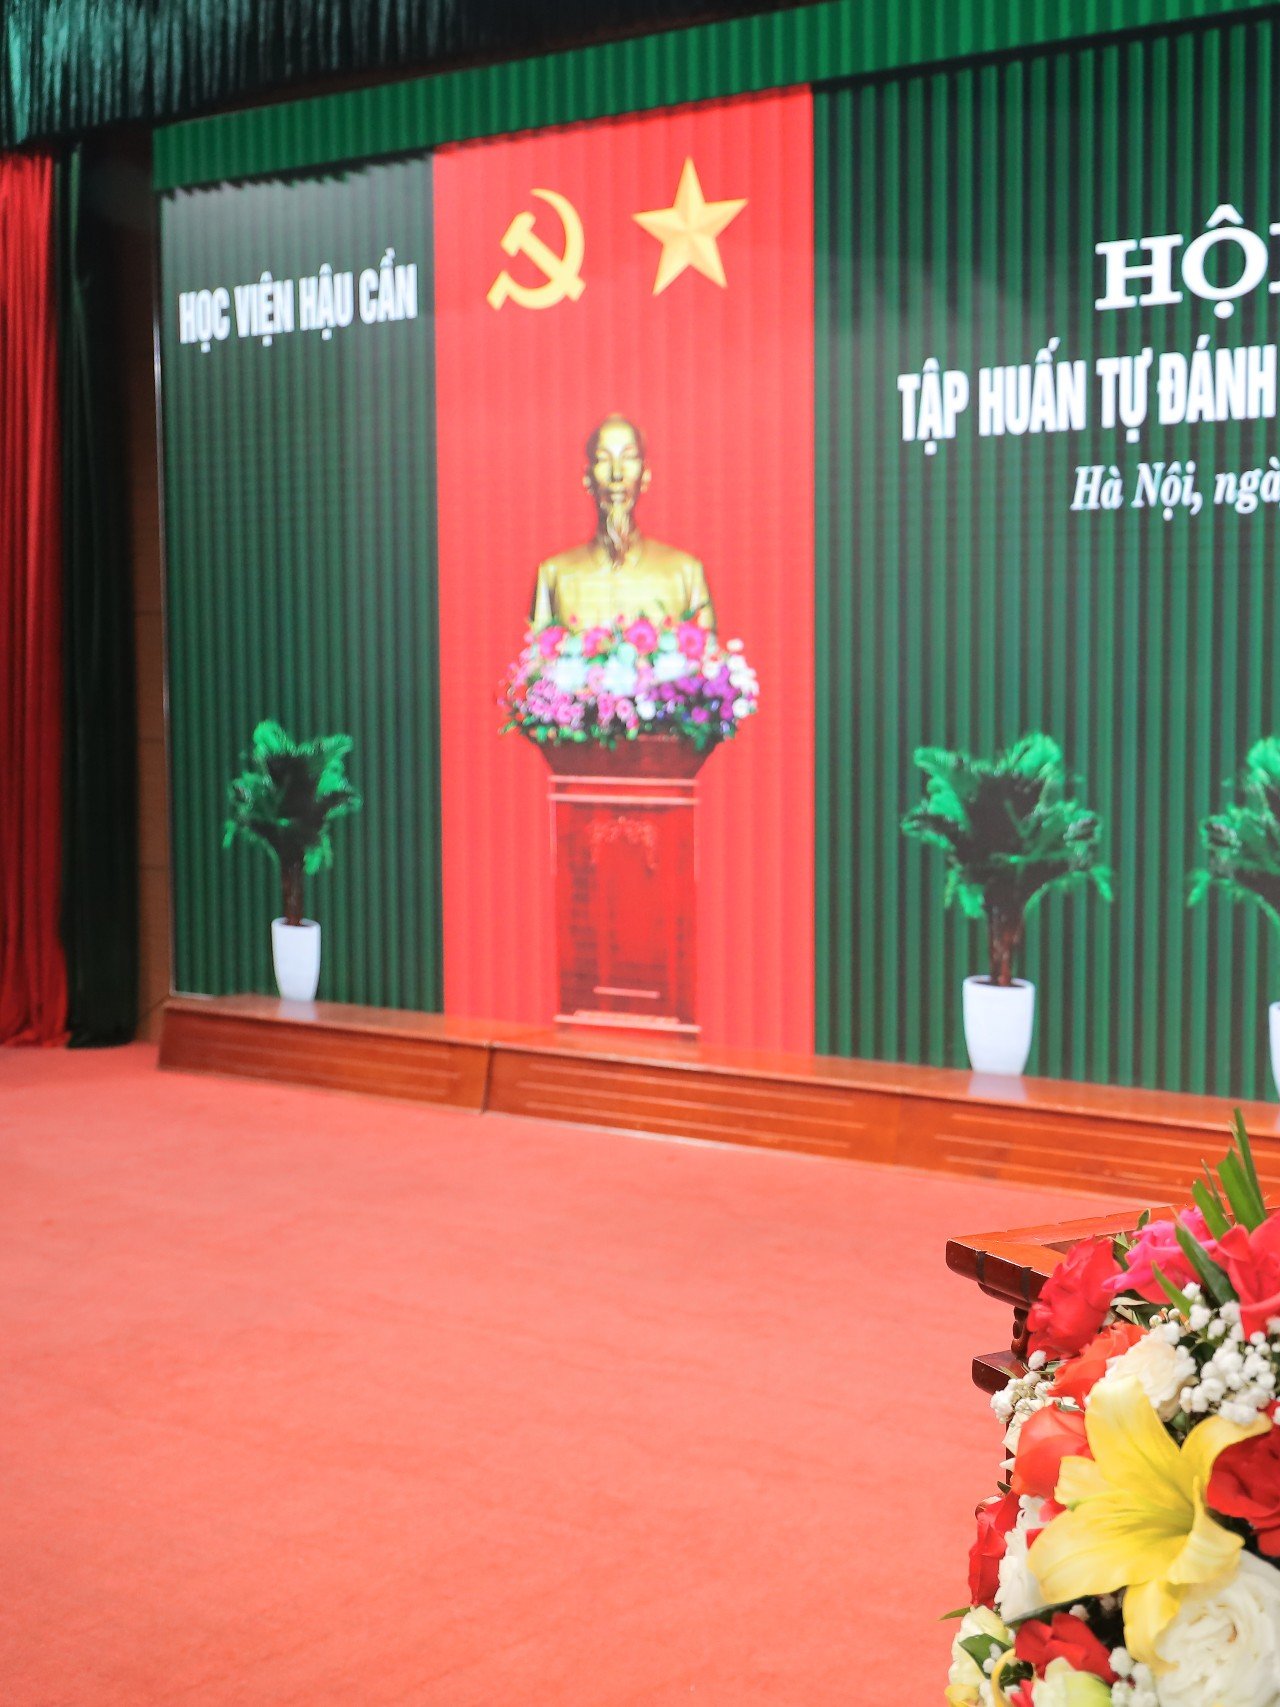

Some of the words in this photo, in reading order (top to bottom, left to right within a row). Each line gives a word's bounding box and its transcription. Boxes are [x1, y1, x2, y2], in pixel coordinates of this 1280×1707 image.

[179, 286, 231, 353] HỌC
[234, 271, 294, 347] VIỆN
[299, 263, 354, 340] HẬU
[898, 358, 969, 455] TẬP
[978, 337, 1086, 436] HUẤN
[1096, 348, 1153, 443] TỰ
[1158, 334, 1276, 425] ĐÁNH
[1070, 464, 1122, 511] Hà
[1132, 460, 1202, 520] Nội,
